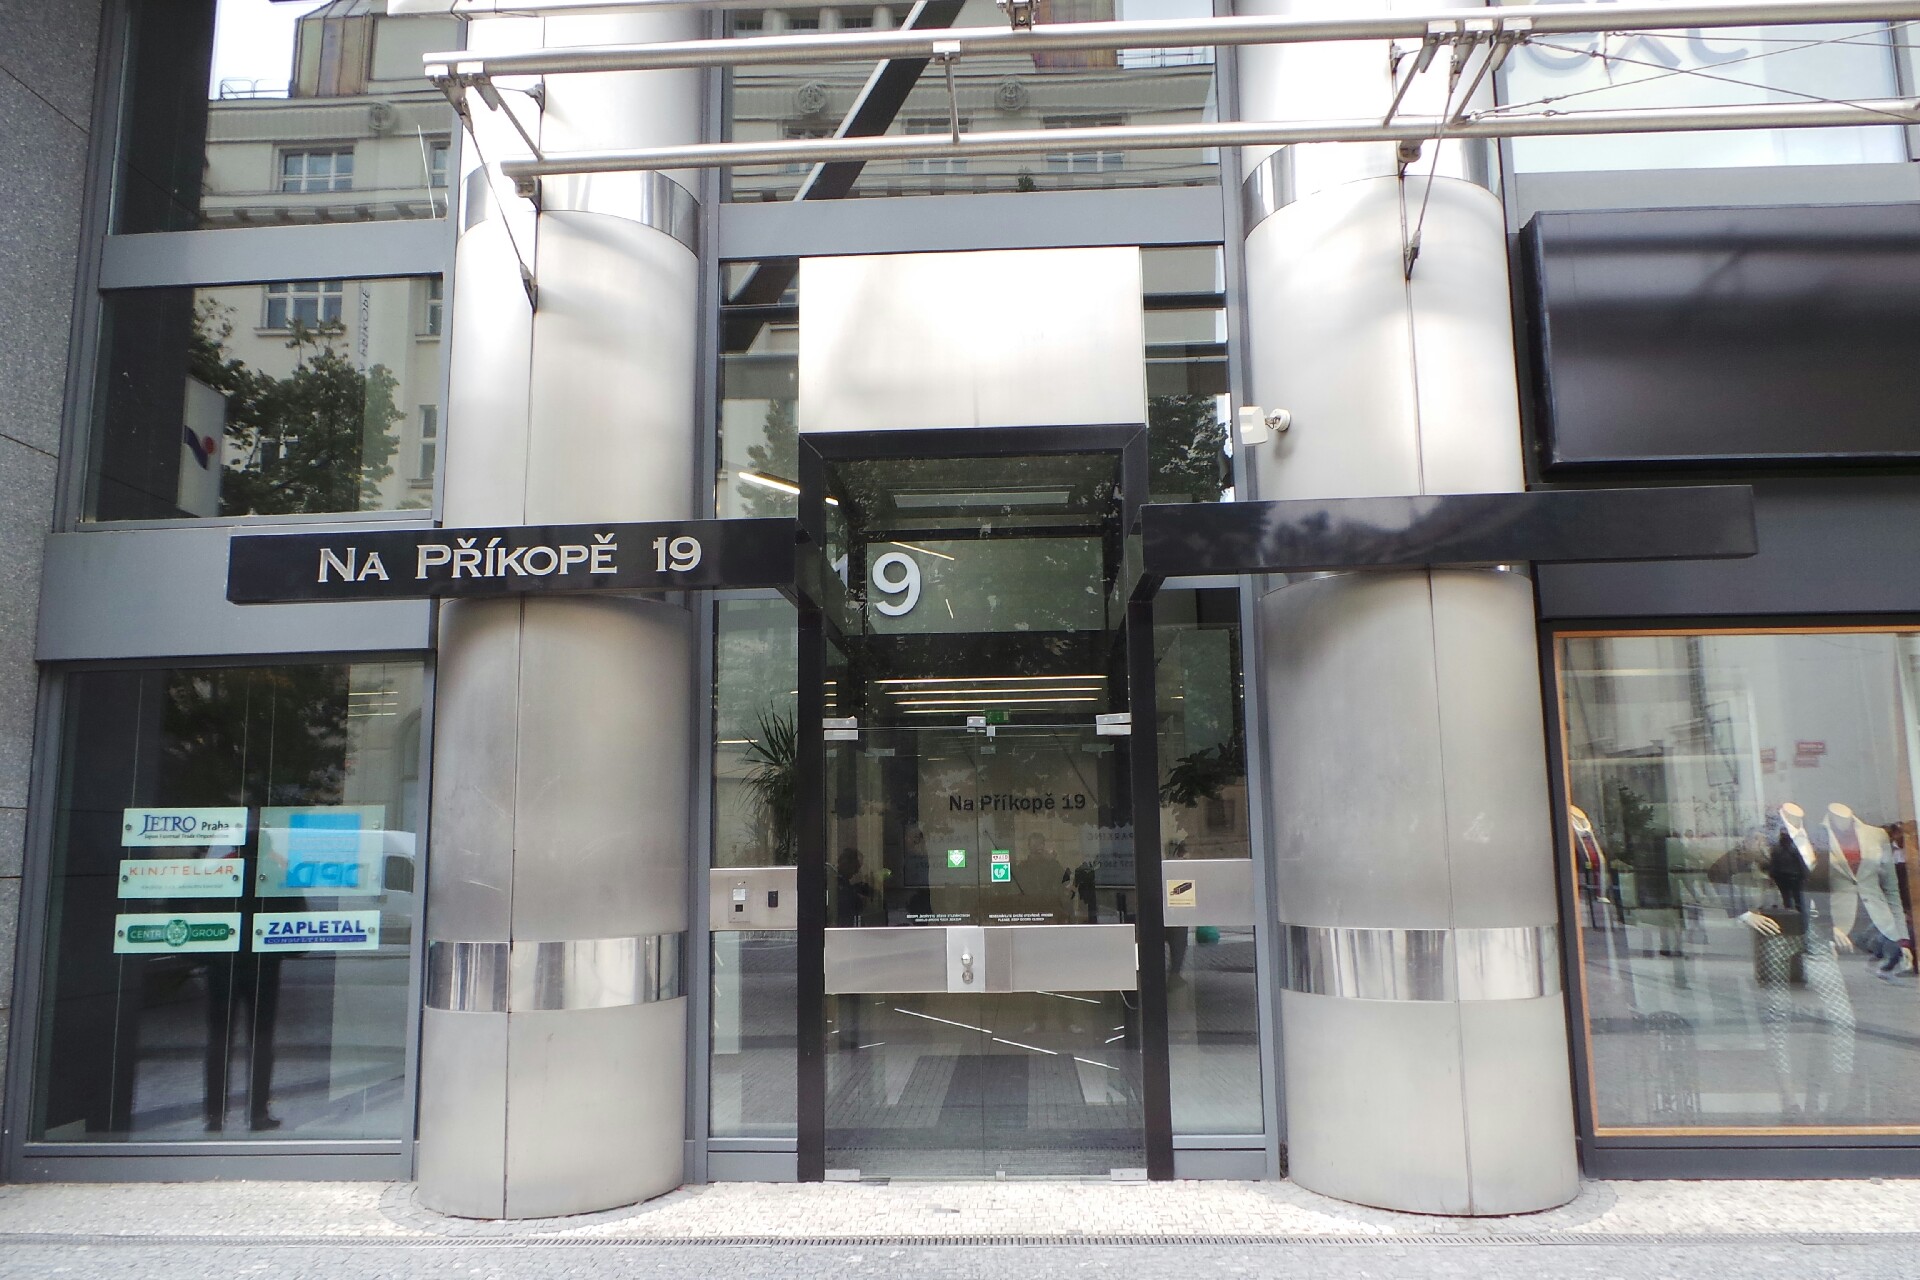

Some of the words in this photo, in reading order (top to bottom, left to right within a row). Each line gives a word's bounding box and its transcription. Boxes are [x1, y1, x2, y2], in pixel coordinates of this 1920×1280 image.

[415, 533, 618, 579] PŘÍKOPĚ
[652, 536, 702, 572] 19
[949, 795, 974, 811] Na
[980, 793, 1055, 813] Příkopě
[1062, 793, 1086, 810] 19
[137, 814, 197, 836] JETRO
[201, 821, 230, 831] Praha
[129, 865, 234, 875] KINSTELLAR
[192, 928, 226, 937] GROUP
[268, 920, 365, 935] ZAPLETAL
